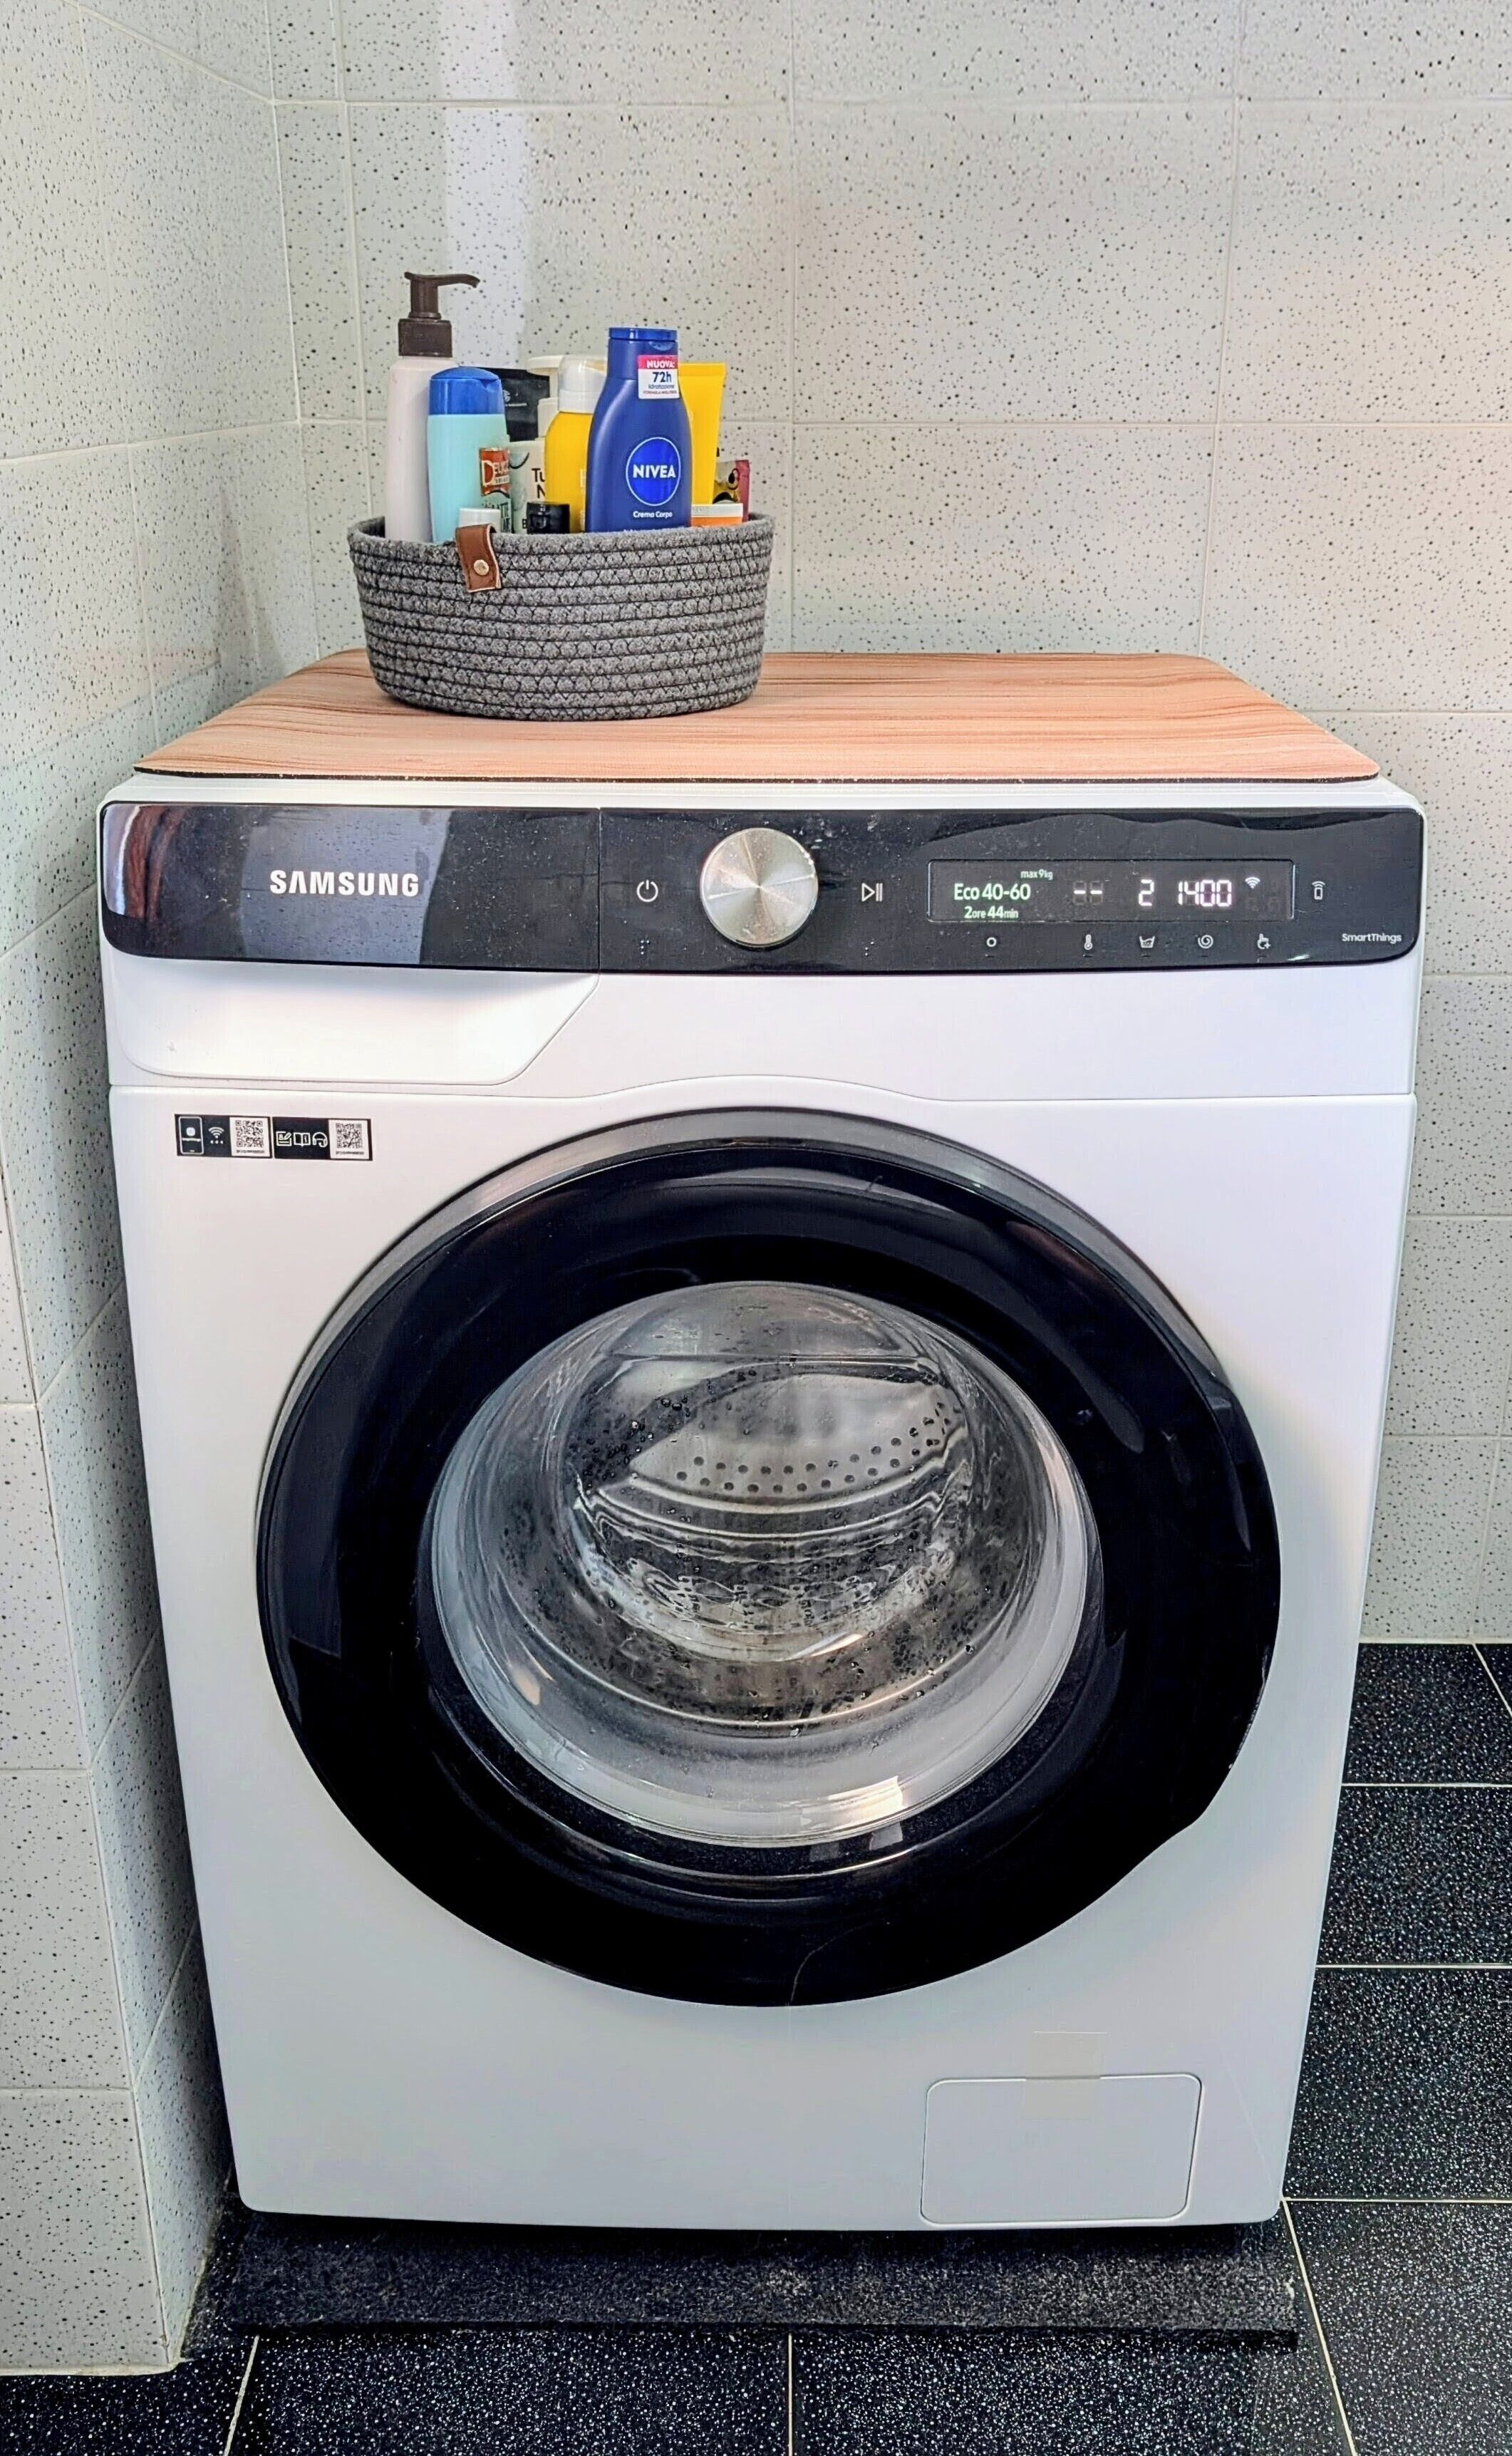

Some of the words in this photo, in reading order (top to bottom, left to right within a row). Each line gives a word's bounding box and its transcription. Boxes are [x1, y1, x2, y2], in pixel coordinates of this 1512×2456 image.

[652, 371, 672, 383] 72h
[633, 465, 676, 478] NIVEA
[656, 511, 673, 519] Corpo
[270, 869, 419, 897] SAMSUNG
[954, 883, 980, 900] Eco
[982, 883, 1031, 900] 40-60
[1138, 879, 1154, 906] 2
[1178, 879, 1232, 907] 1400
[1342, 933, 1402, 944] SmartThings
